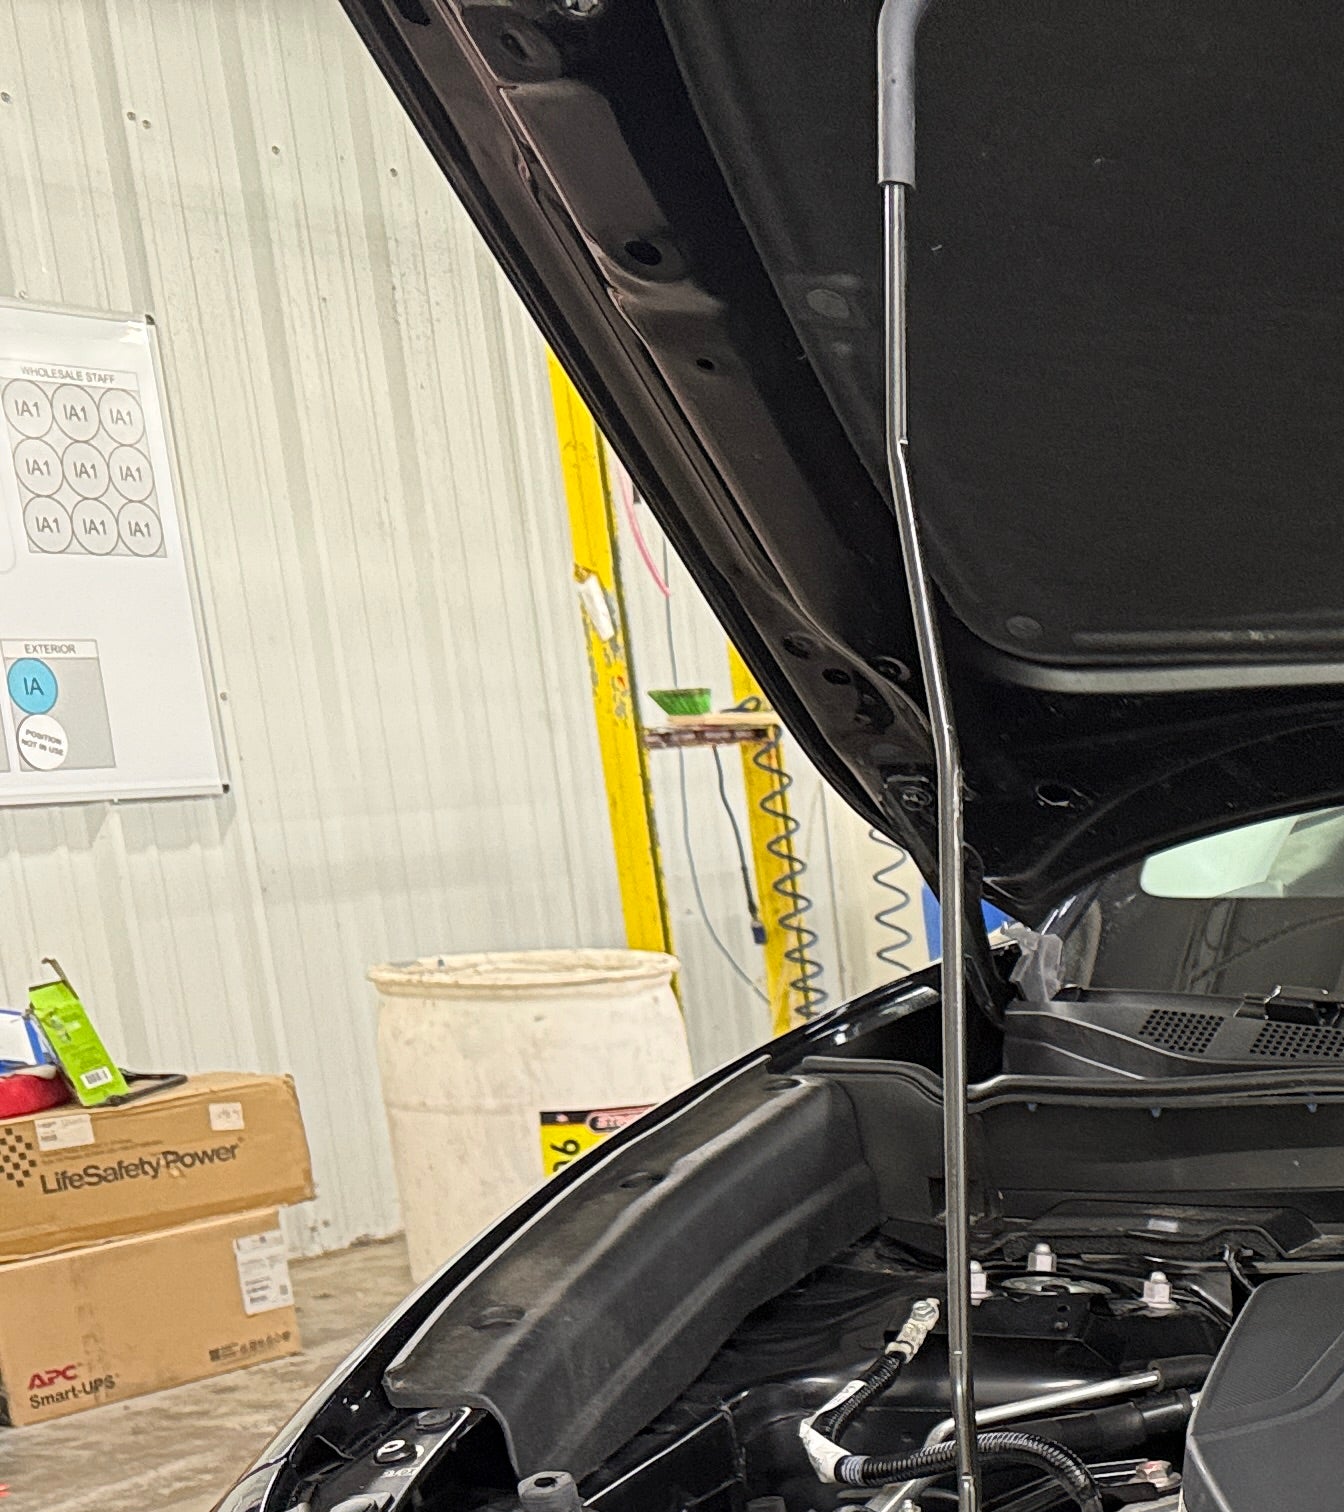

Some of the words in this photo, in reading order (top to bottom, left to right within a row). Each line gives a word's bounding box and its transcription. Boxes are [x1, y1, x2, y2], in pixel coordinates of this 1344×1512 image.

[20, 365, 83, 382] WHOLESALE
[85, 371, 116, 384] STAFF
[14, 399, 41, 417] IA1
[63, 403, 88, 422] IA1
[109, 407, 133, 426] IA1
[25, 458, 51, 476] IA1
[73, 461, 98, 479] IA1
[119, 465, 143, 482] IA1
[35, 515, 61, 533] IA1
[82, 517, 107, 535] IA1
[127, 520, 151, 537] IA1
[24, 643, 77, 654] EXTERIOR
[23, 676, 45, 696] IA
[25, 728, 62, 745] POSITION
[21, 738, 38, 748] NOT
[39, 743, 47, 752] IN
[48, 747, 64, 756] USE
[28, 1364, 78, 1391] APC
[29, 1374, 116, 1409] Smart-UPS
